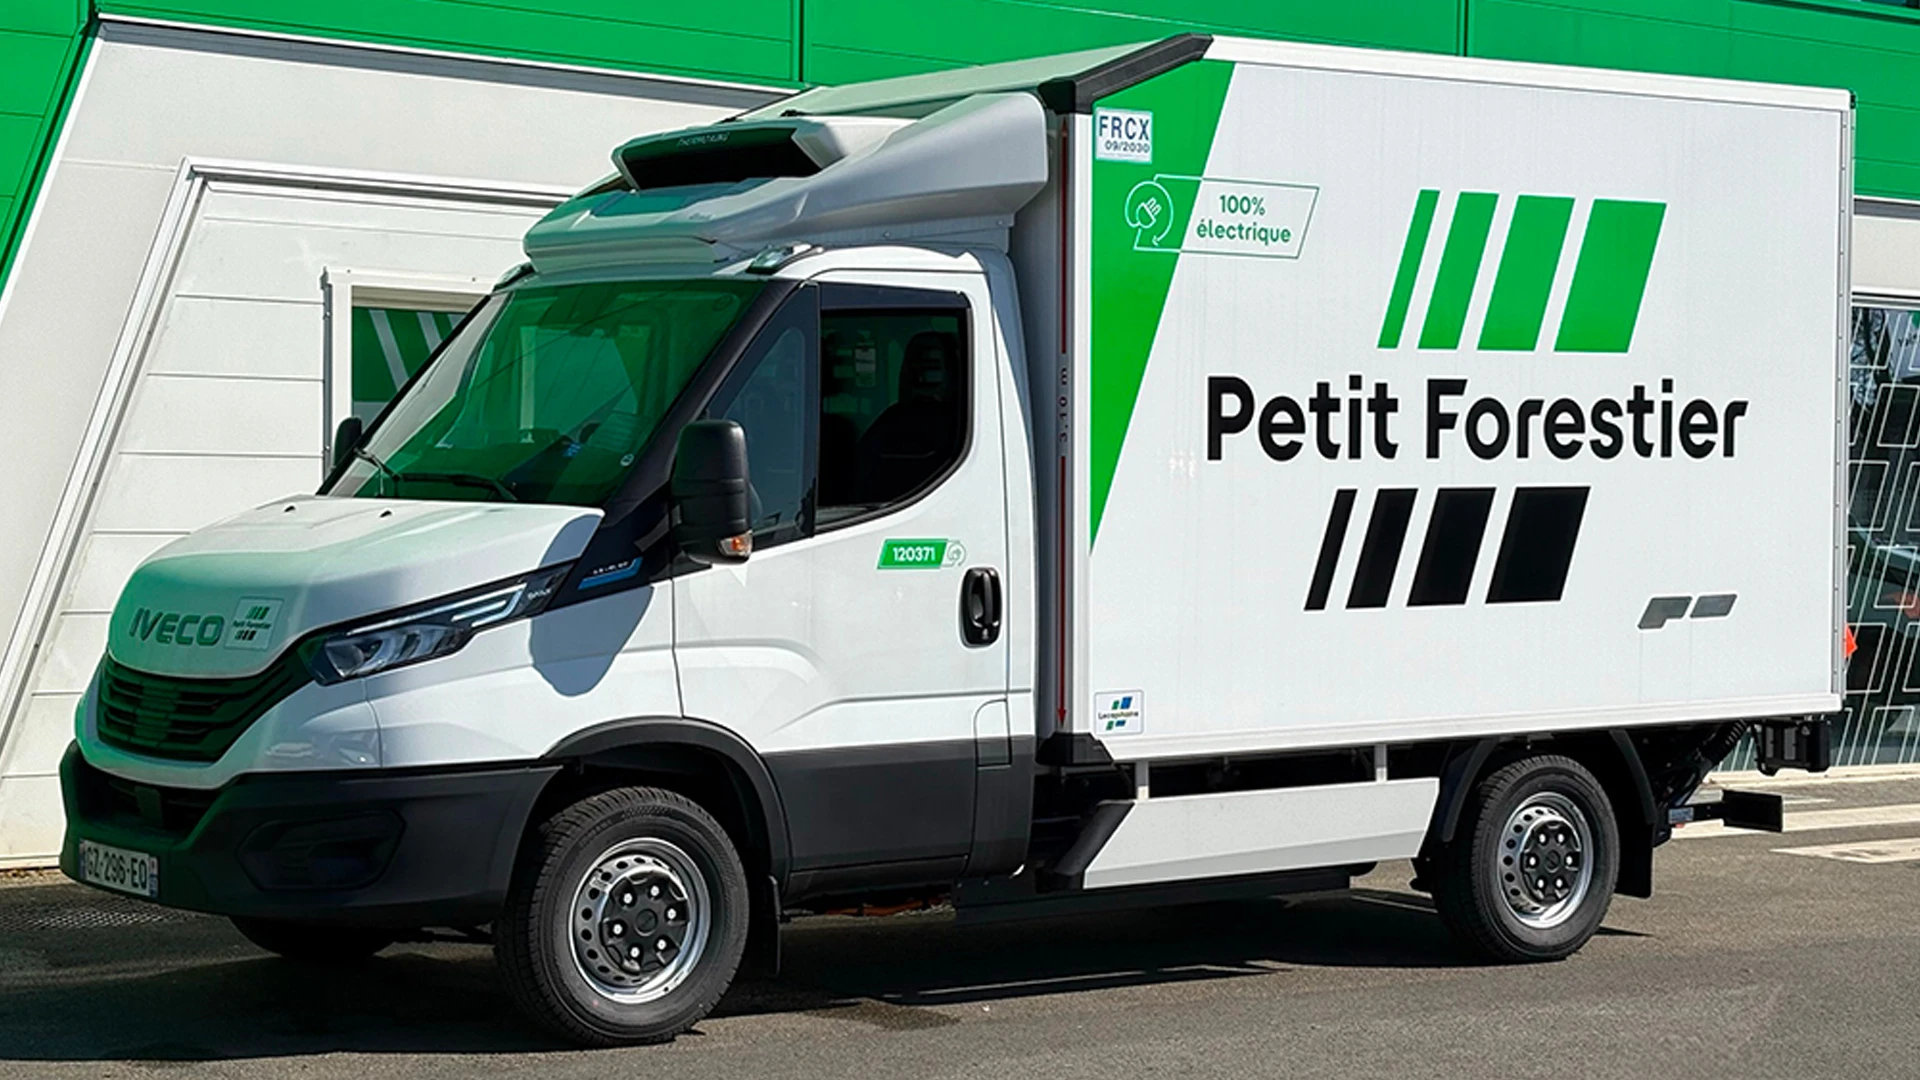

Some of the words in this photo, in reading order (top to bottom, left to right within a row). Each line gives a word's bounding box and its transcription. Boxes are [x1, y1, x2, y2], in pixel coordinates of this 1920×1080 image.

[1099, 116, 1149, 141] FRCX
[1105, 140, 1150, 153] 09/2030
[1220, 195, 1266, 216] 100%
[1196, 218, 1291, 246] électrique
[1207, 374, 1398, 461] Petit
[1426, 378, 1748, 461] Forestier
[893, 546, 936, 561] 120371
[129, 607, 225, 646] IVECO
